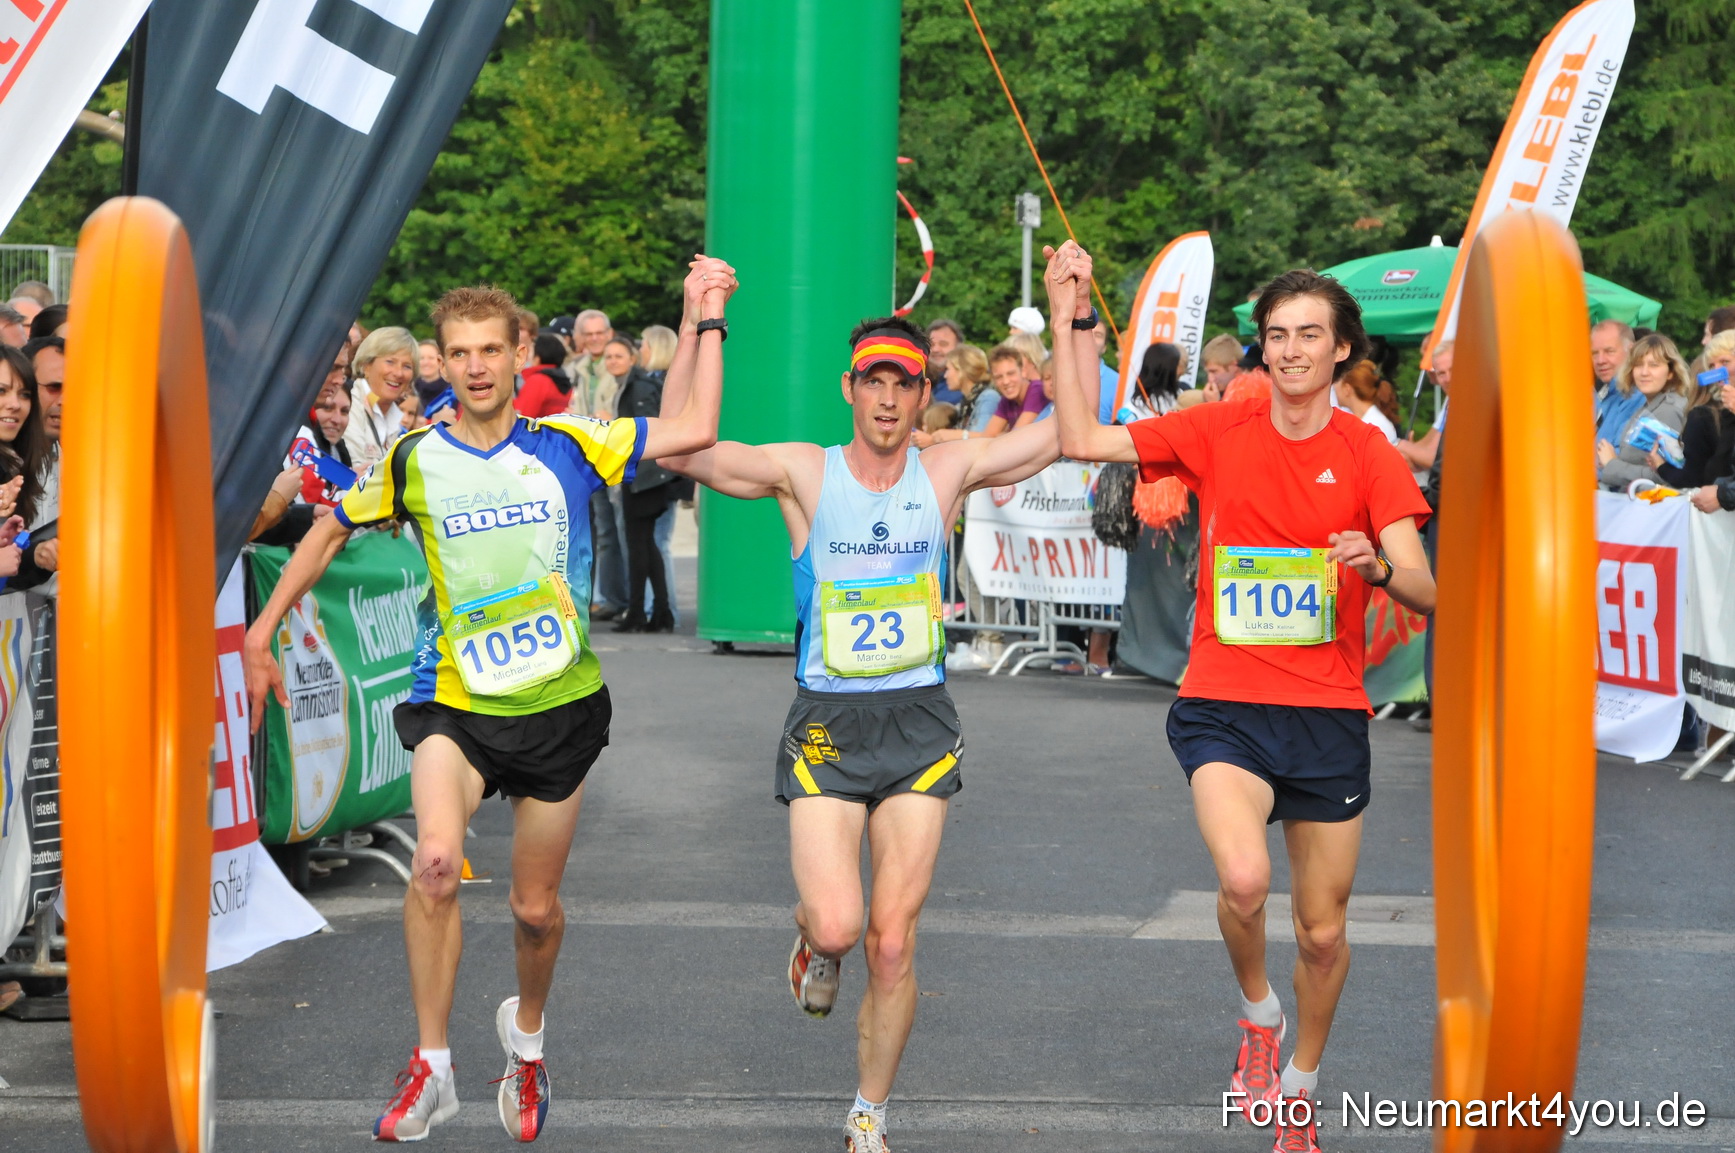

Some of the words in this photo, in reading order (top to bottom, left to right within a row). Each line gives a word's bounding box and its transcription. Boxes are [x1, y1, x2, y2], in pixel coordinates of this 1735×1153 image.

[1506, 34, 1598, 211] LEBL
[1552, 59, 1618, 207] www.klebl.de
[441, 489, 509, 512] TEAM
[443, 500, 550, 539] BOCK
[829, 541, 929, 555] SCHABMÜLLER
[867, 561, 892, 570] TEAM
[1221, 582, 1321, 618] 1104
[850, 611, 905, 652] 23
[1245, 621, 1274, 630] Lukas
[1594, 559, 1660, 682] ER
[461, 614, 562, 674] 1059
[857, 653, 887, 662] Marco
[493, 662, 531, 682] Michael
[36, 801, 57, 815] eizeit
